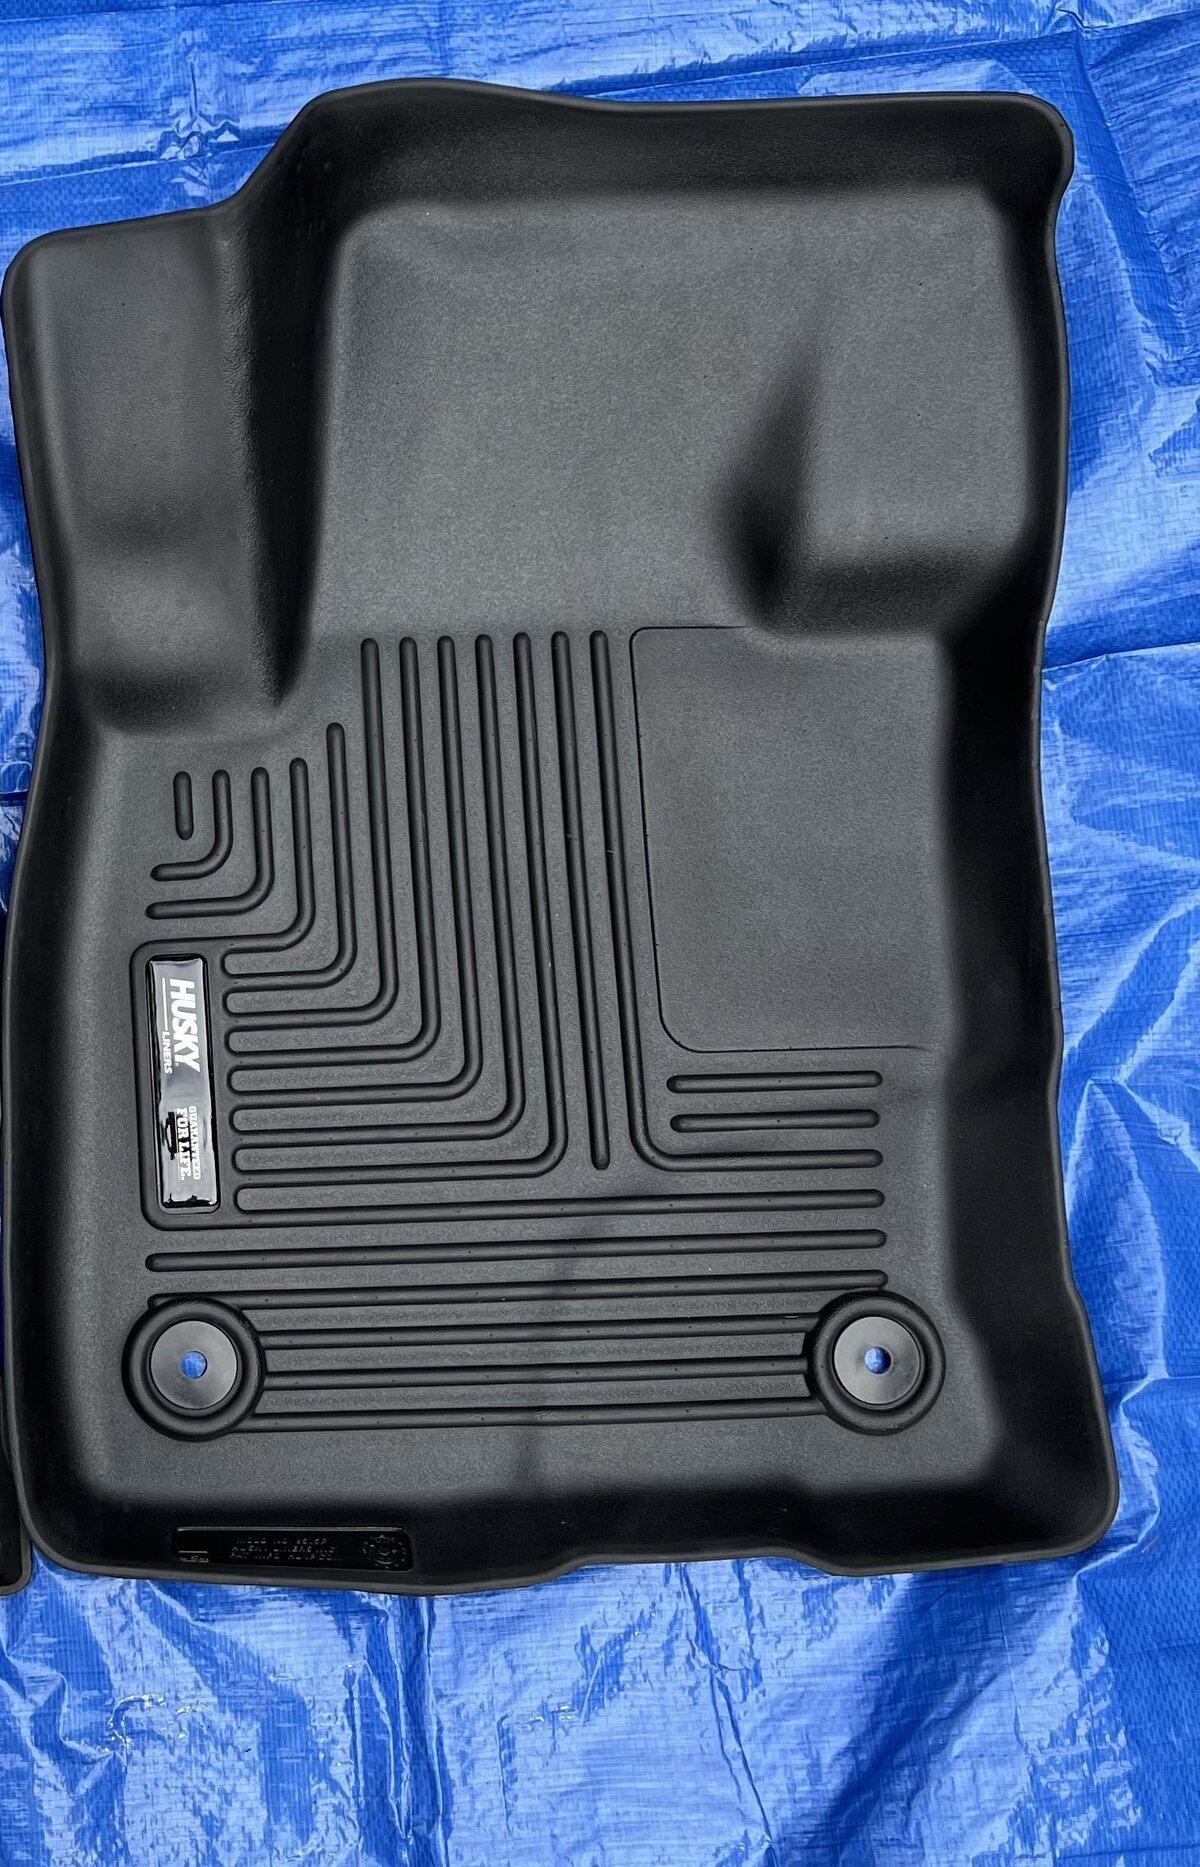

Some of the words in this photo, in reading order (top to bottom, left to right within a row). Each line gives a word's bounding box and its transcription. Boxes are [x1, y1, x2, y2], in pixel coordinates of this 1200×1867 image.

[162, 1030, 173, 1074] LINERS
[169, 978, 201, 1072] HUSKY
[176, 1107, 189, 1140] FOR
[188, 1105, 201, 1180] GUARANTEED
